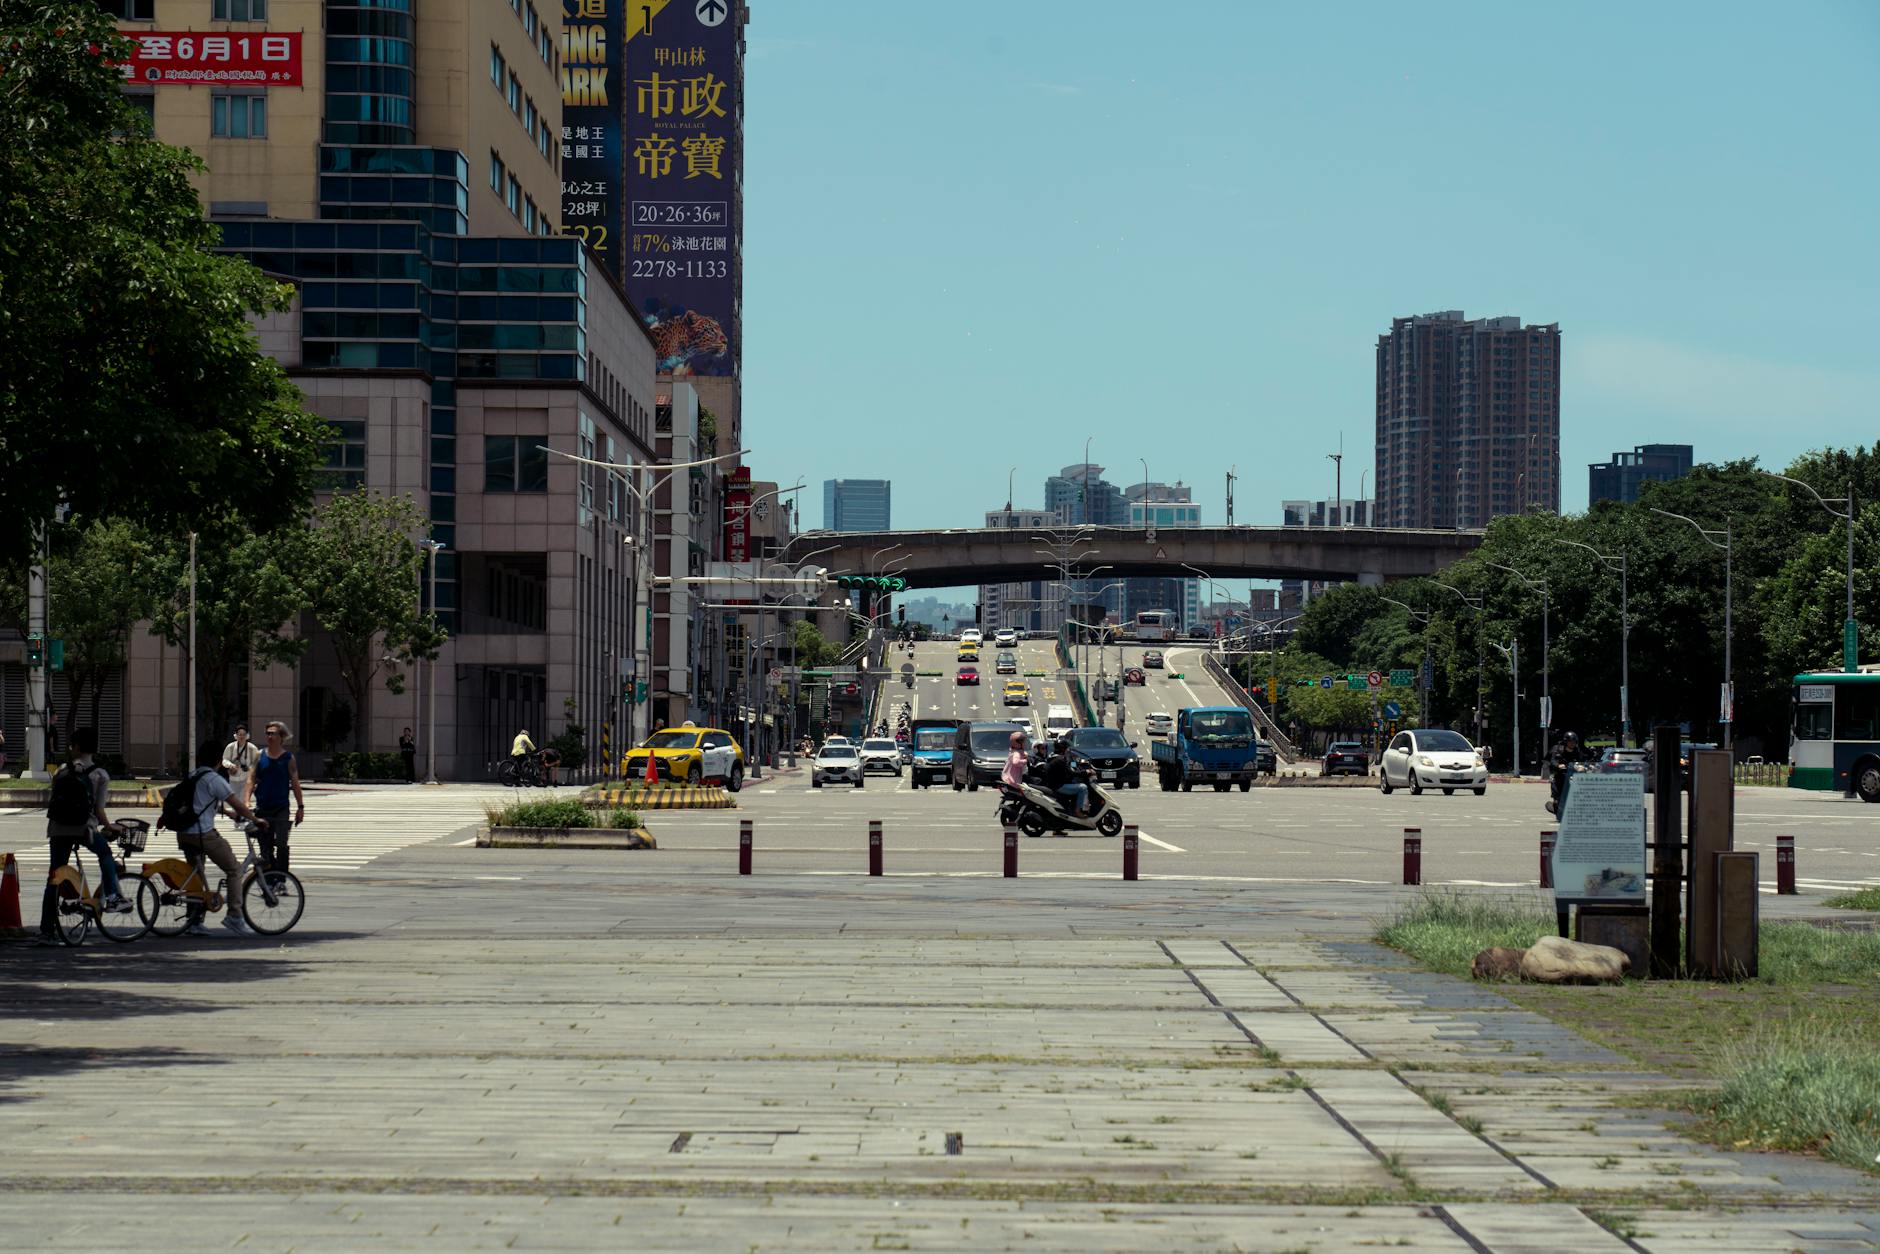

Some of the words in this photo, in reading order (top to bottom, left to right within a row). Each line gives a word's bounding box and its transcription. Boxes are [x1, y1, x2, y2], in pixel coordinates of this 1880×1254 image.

[562, 0, 607, 18] 道
[122, 36, 291, 61] 至6月1日
[655, 46, 706, 67] 甲山林
[633, 71, 728, 119] 市政
[561, 126, 605, 141] 是地王
[561, 144, 605, 159] 是國王
[633, 132, 727, 180] 帝寶
[671, 236, 727, 251] 泳池花園
[631, 260, 727, 278] 2278-1133
